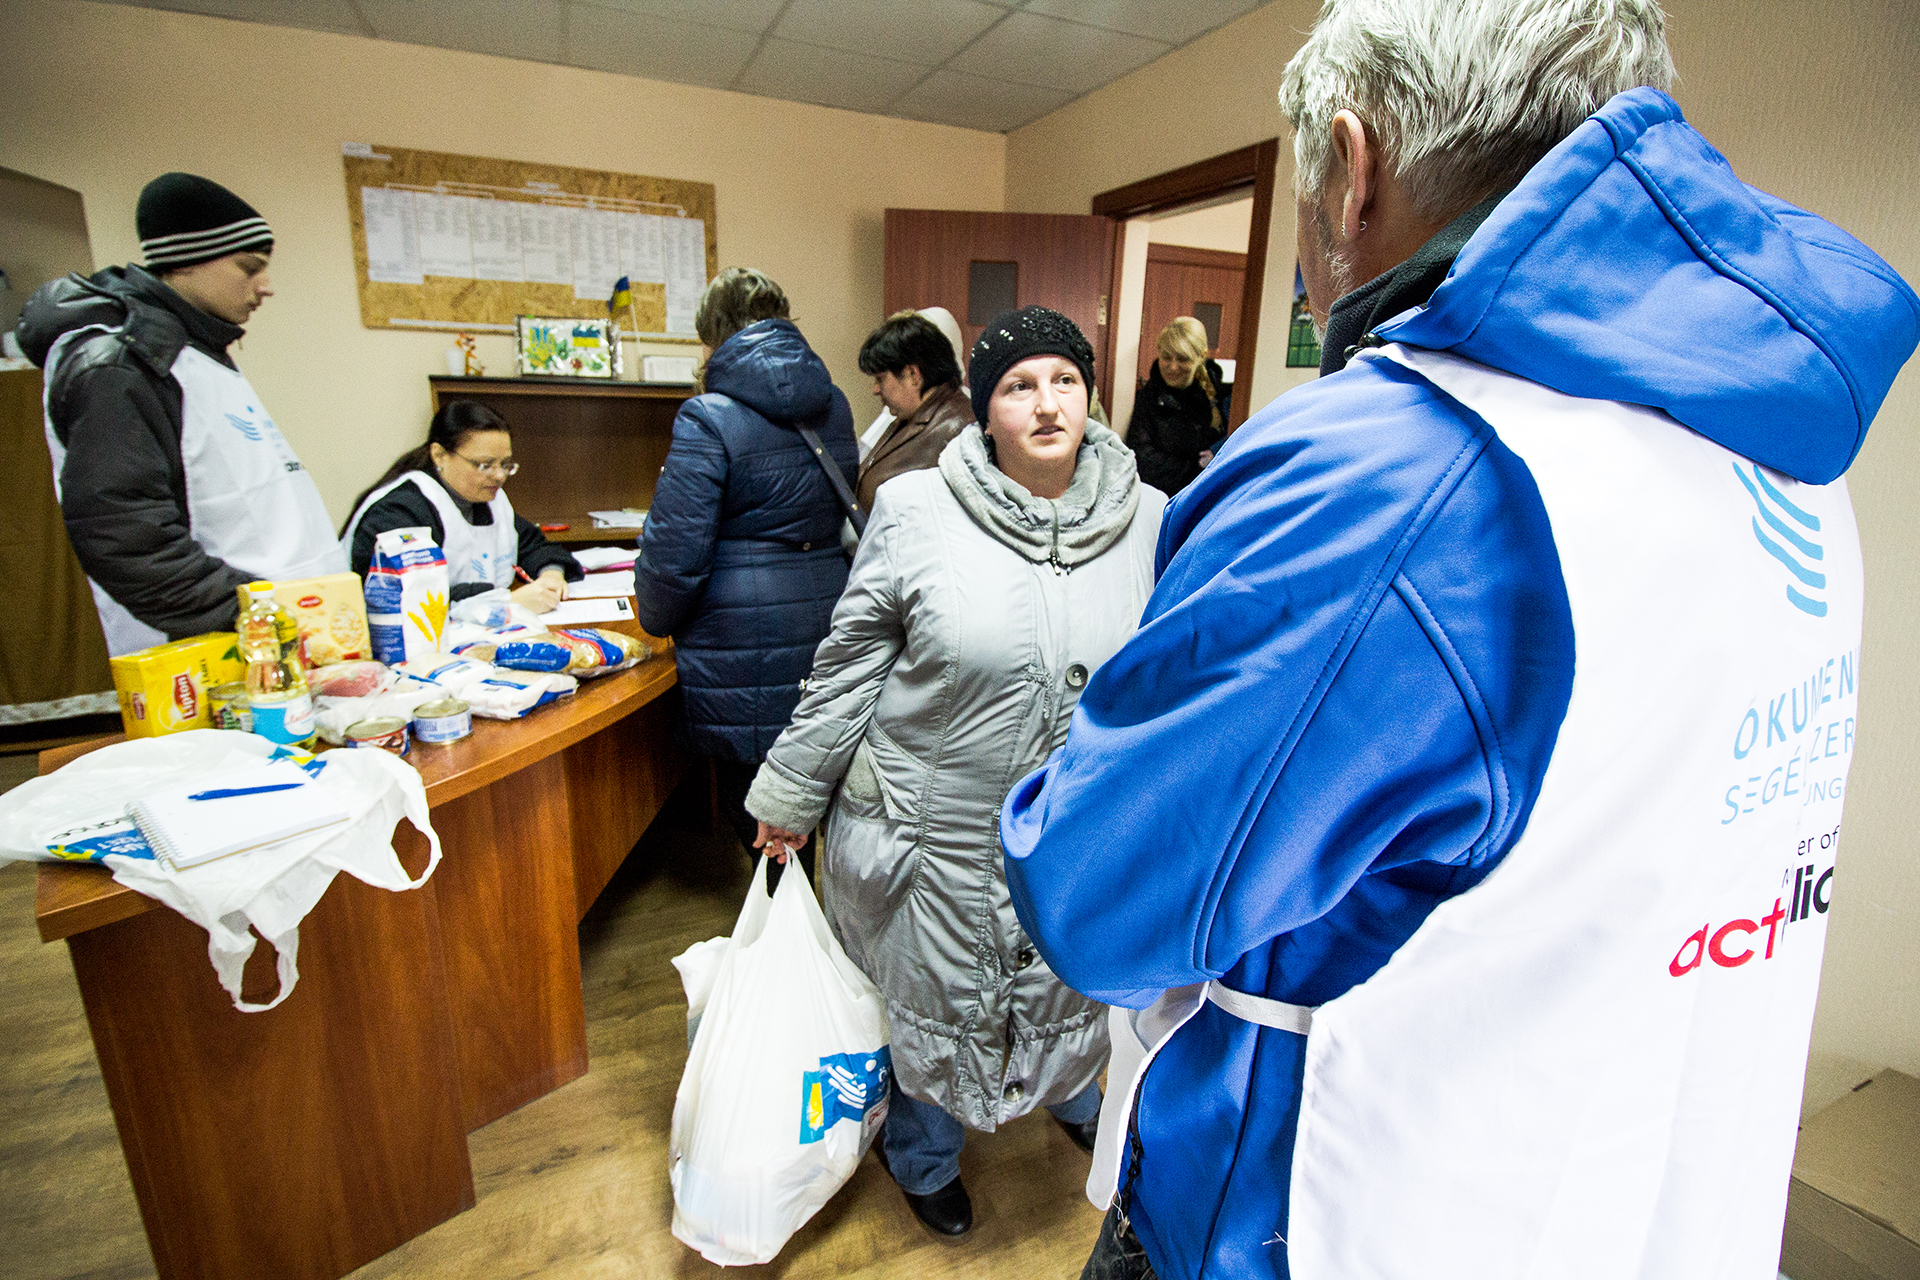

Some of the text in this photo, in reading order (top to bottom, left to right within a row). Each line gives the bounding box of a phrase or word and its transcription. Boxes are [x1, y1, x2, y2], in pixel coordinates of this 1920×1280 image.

[178, 676, 194, 717] Lipton
[1797, 825, 1840, 856] er of
